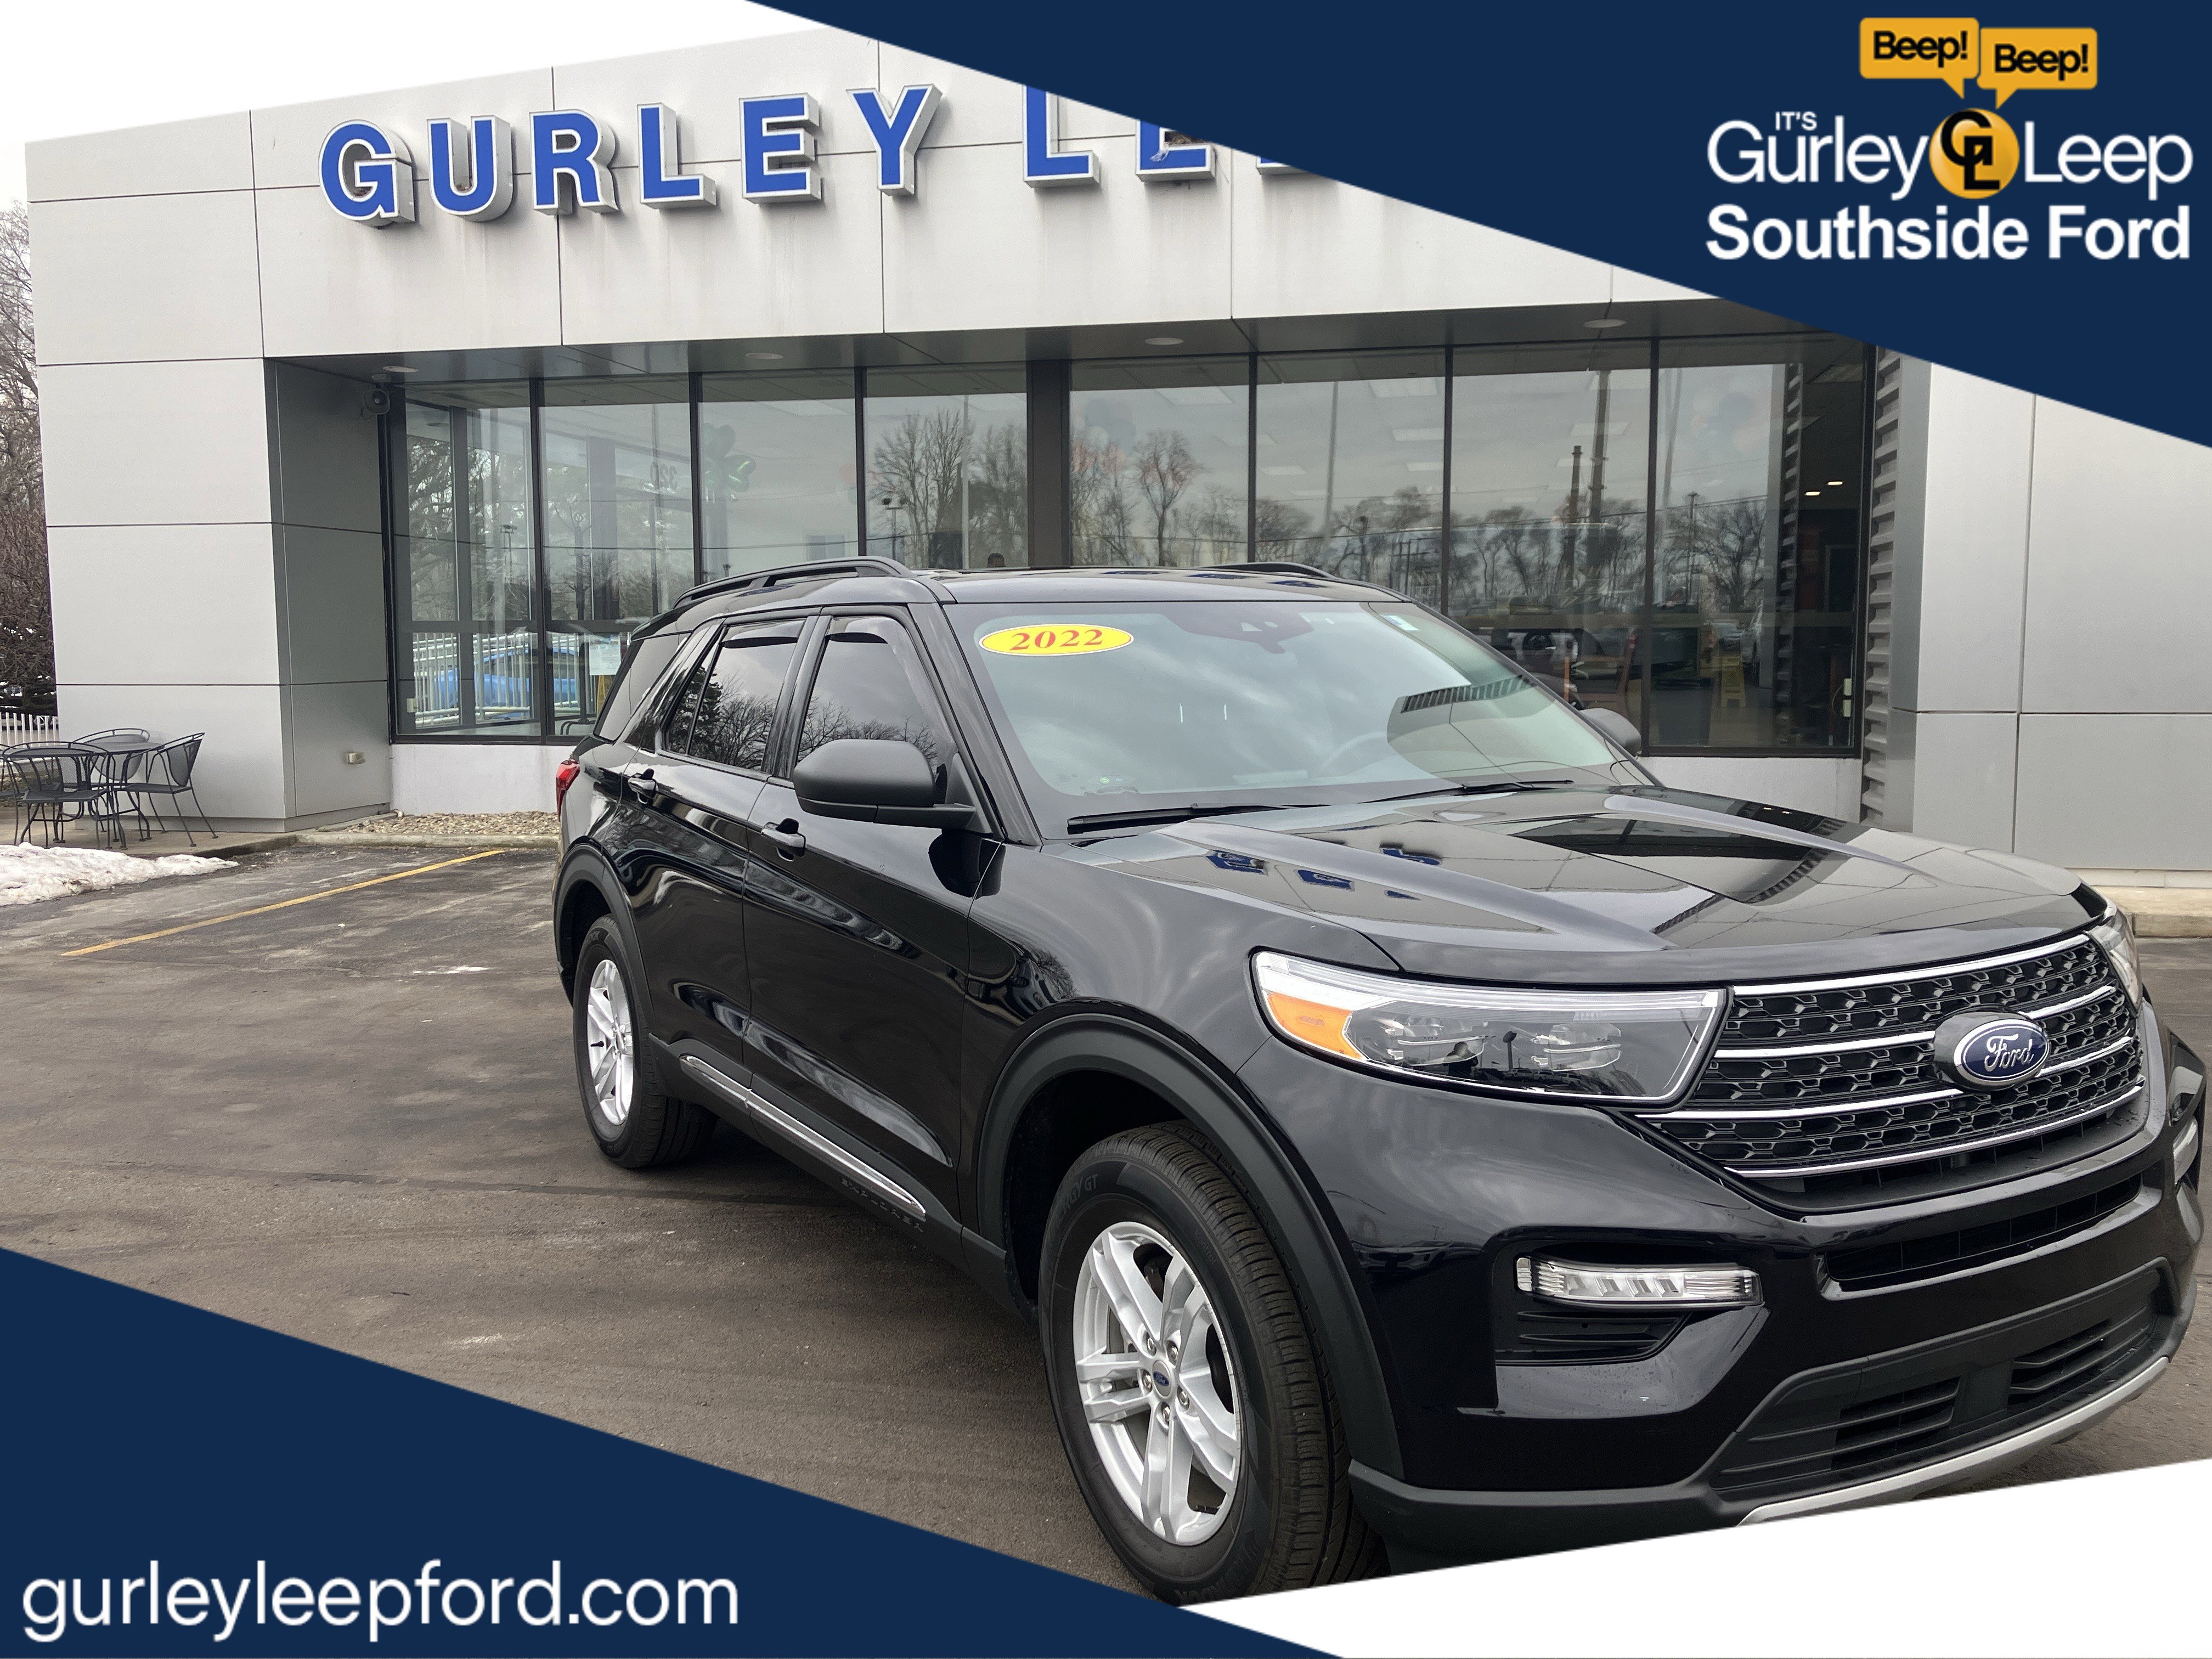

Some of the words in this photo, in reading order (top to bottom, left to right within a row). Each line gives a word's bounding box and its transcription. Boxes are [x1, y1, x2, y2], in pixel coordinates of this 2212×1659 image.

[318, 84, 943, 226] GURLEY
[1009, 629, 1103, 652] 2022
[1983, 1033, 2035, 1073] Ford
